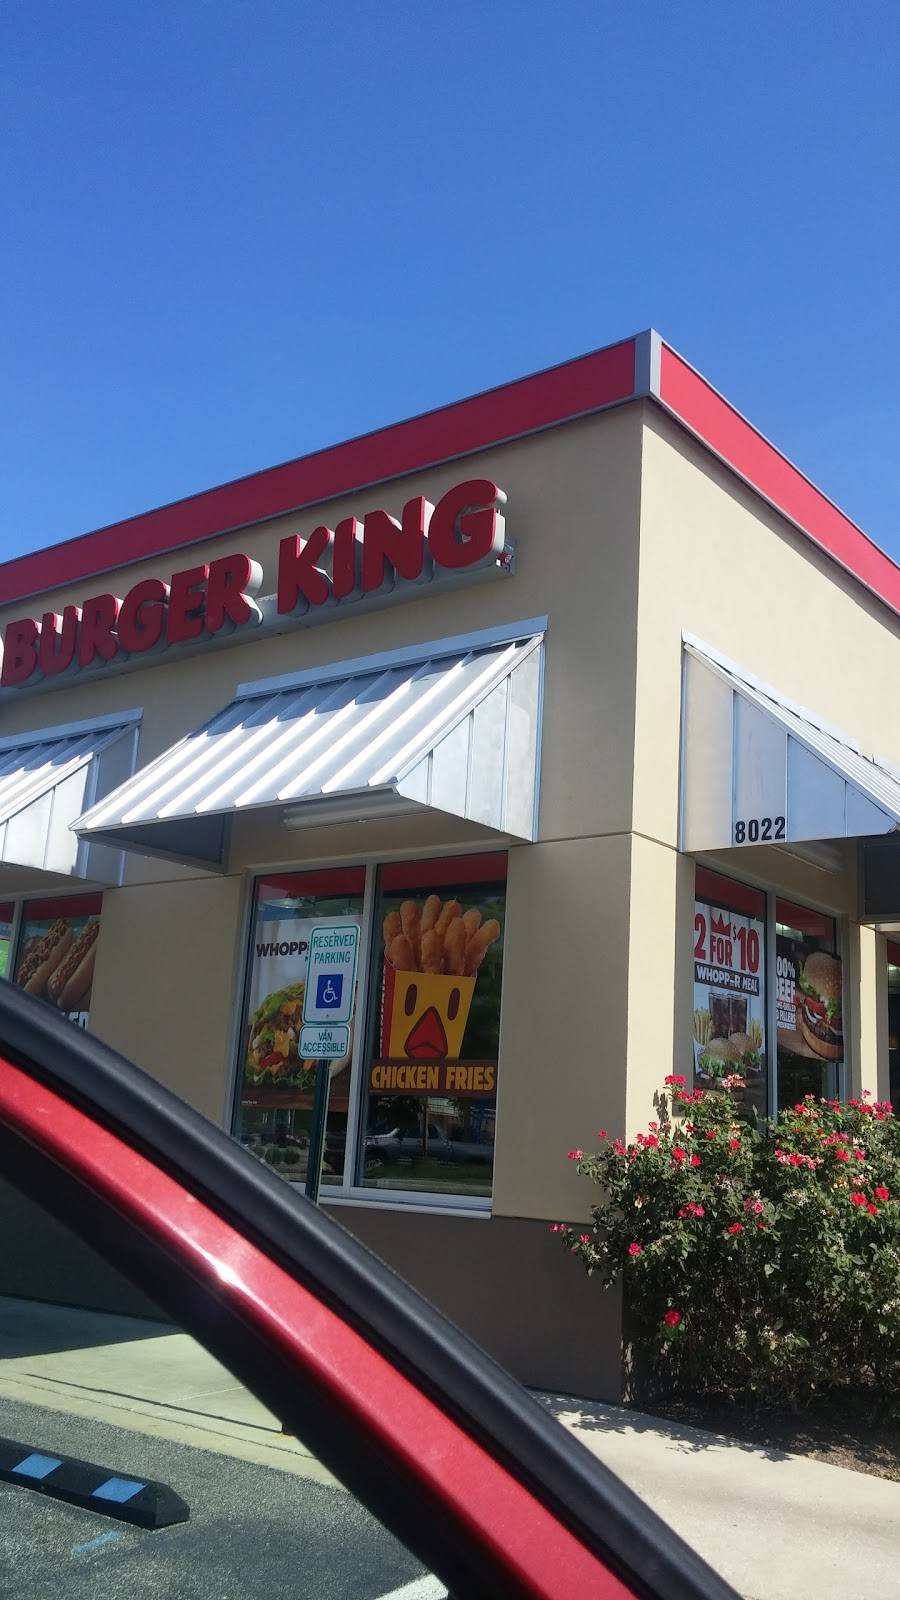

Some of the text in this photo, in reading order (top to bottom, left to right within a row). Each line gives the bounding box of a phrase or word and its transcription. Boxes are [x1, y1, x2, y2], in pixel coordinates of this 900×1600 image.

[1, 479, 502, 687] BURGER KING
[735, 816, 786, 843] 8022
[313, 934, 355, 948] RESERVED
[694, 913, 706, 960] 2
[710, 935, 733, 967] FOR
[256, 941, 310, 957] WHOPP
[314, 951, 351, 964] PARKING
[775, 955, 796, 978] 00%
[742, 976, 758, 993] MEAL
[318, 1031, 333, 1042] VAN
[302, 1041, 345, 1052] ACCESSIBLE
[371, 1066, 495, 1091] CHICKEN FRIES
